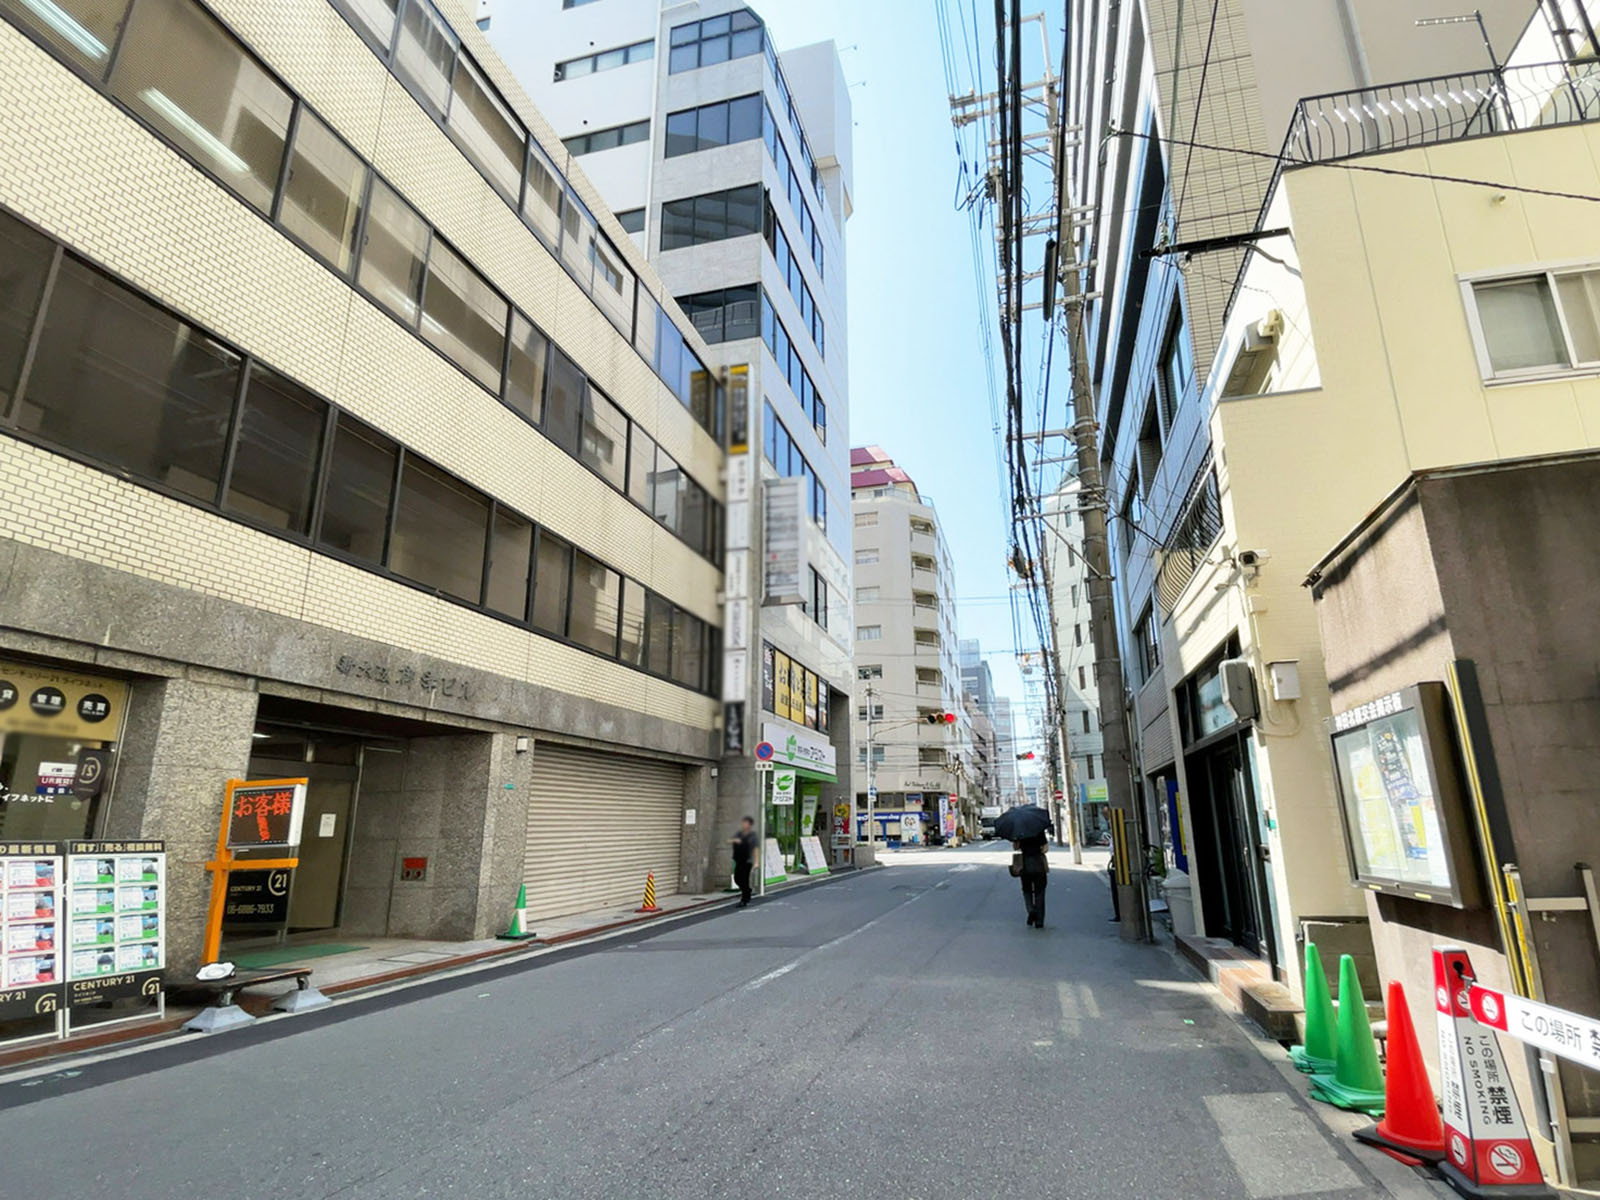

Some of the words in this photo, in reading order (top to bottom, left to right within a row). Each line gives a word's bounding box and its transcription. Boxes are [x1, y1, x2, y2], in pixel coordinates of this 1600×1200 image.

[234, 792, 292, 817] お客様
[15, 990, 27, 1000] 21
[73, 976, 123, 991] CENTURY
[125, 975, 136, 984] 21
[148, 983, 160, 994] 21
[42, 999, 56, 1012] 21
[1521, 1010, 1583, 1051] この場所
[1479, 1035, 1500, 1083] この場所
[1463, 1035, 1475, 1056] NO
[1469, 1060, 1492, 1126] SMOKING
[1487, 1086, 1515, 1125] 禁煙
